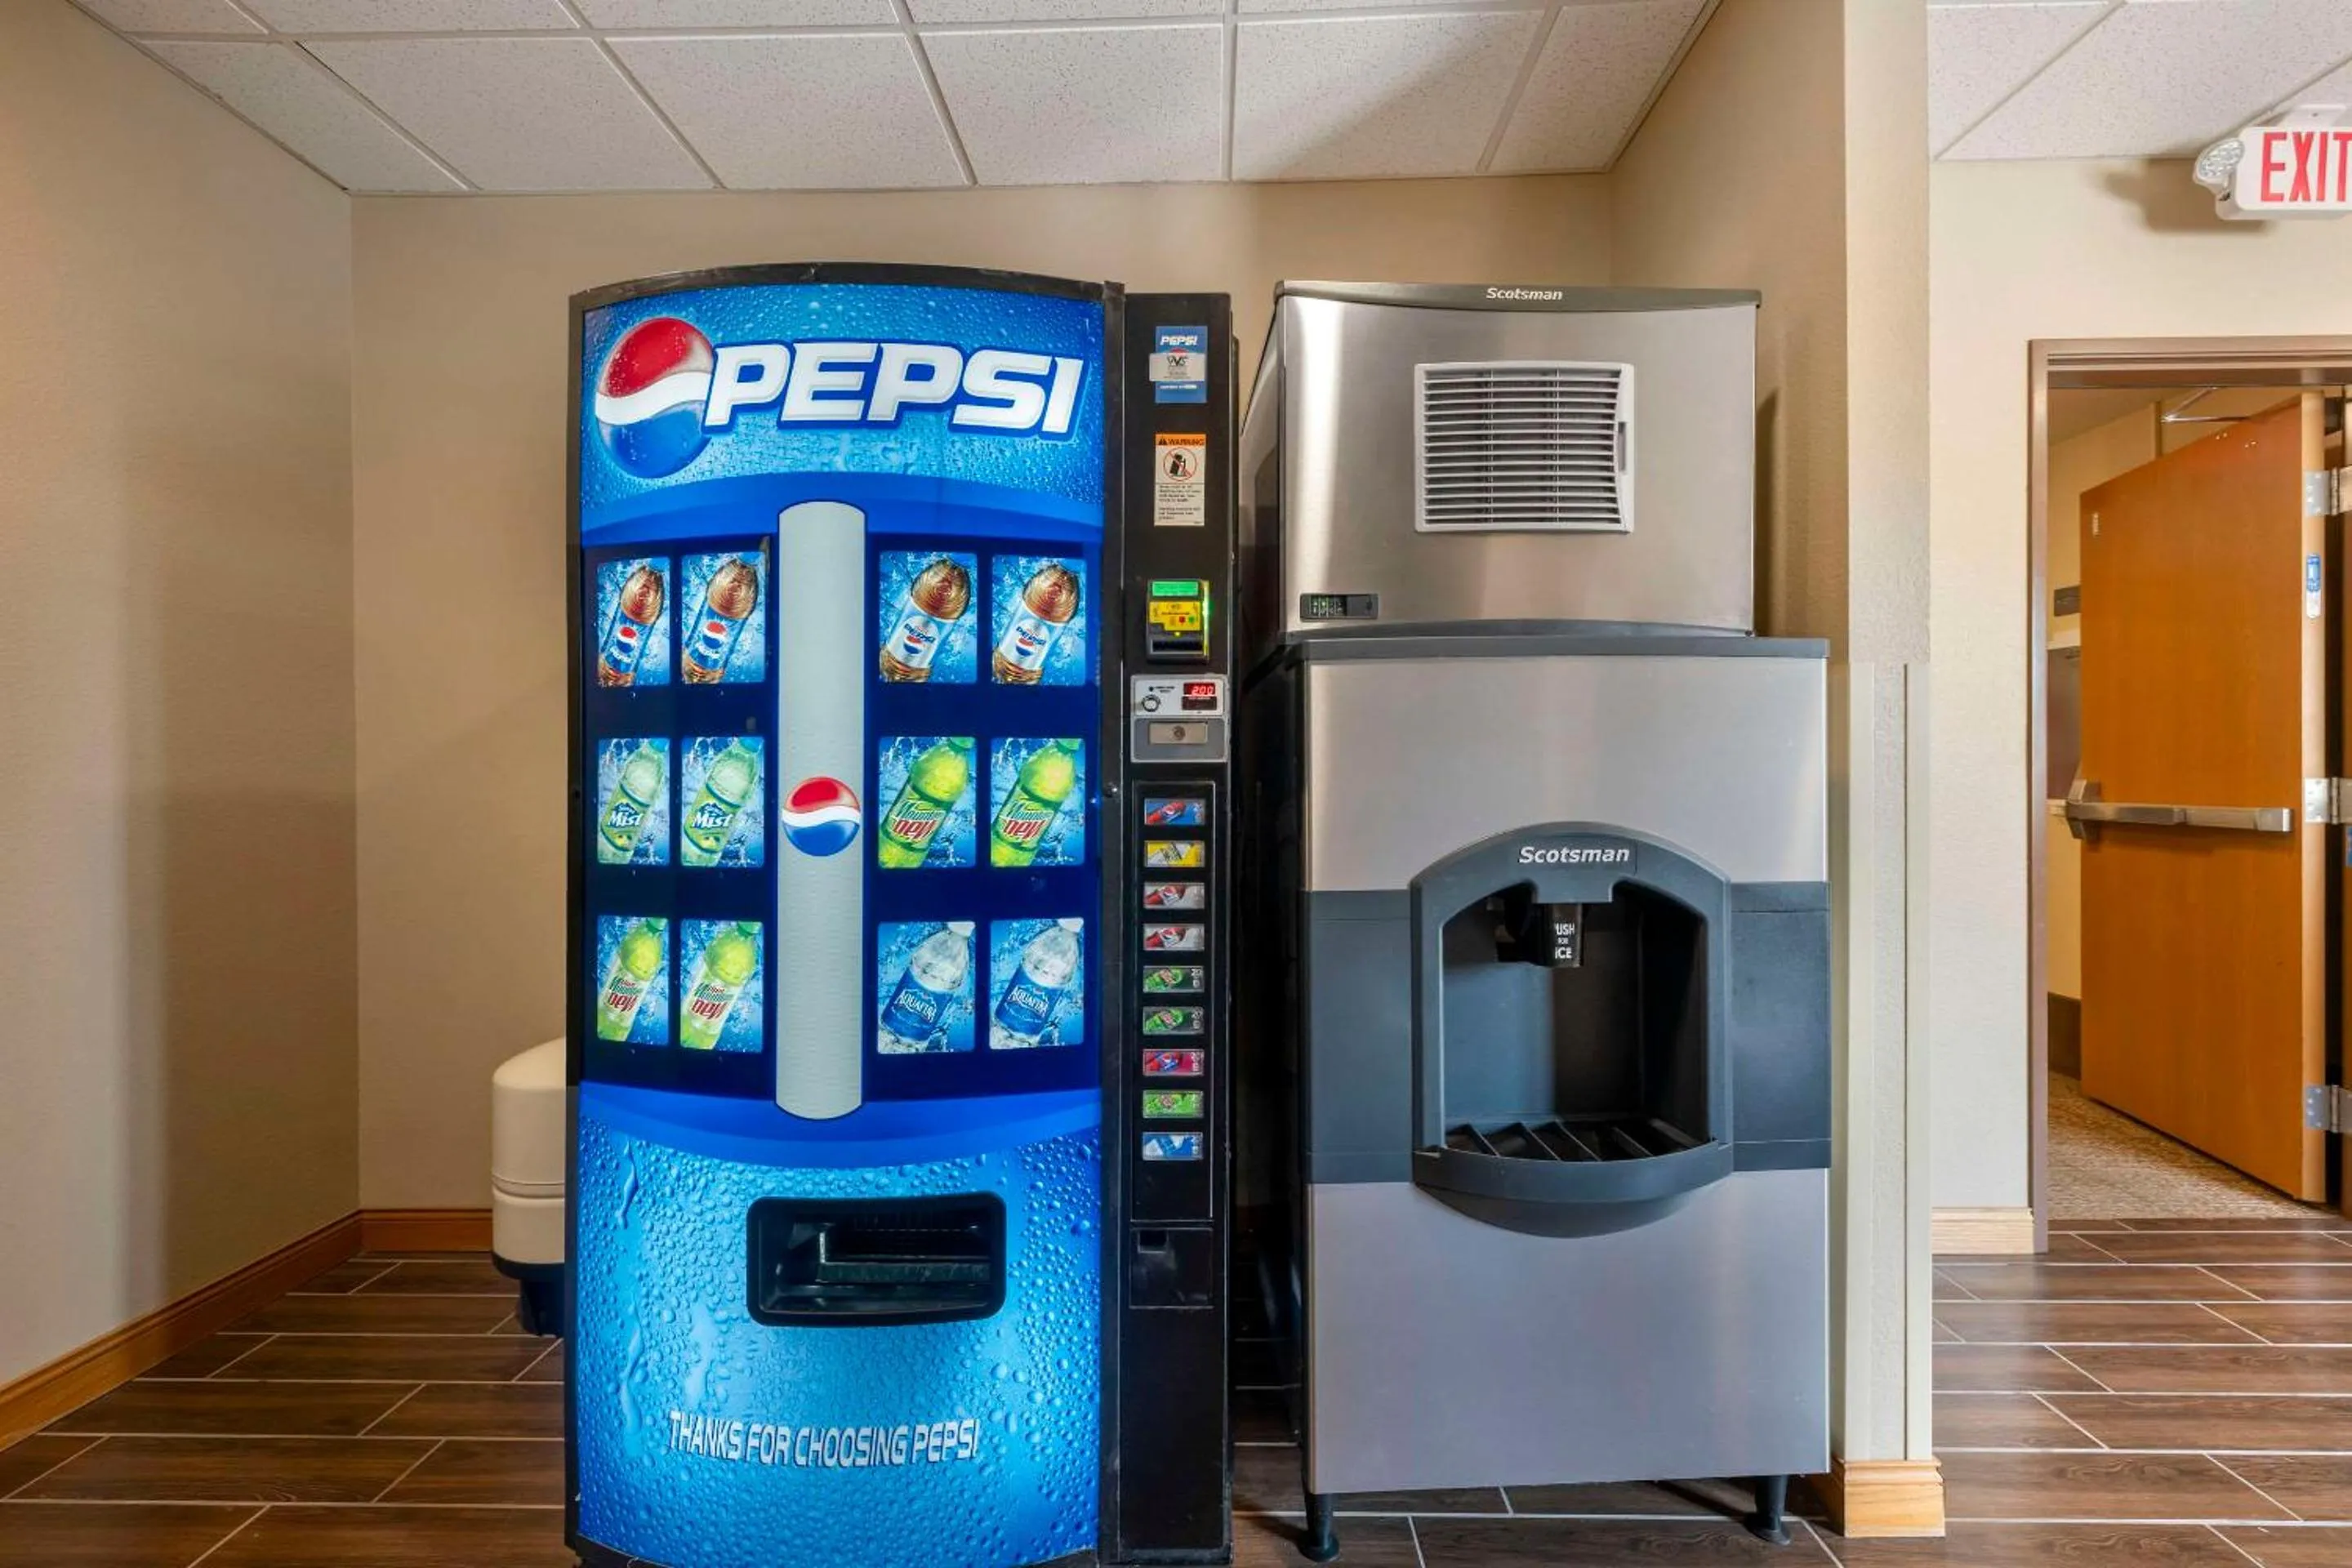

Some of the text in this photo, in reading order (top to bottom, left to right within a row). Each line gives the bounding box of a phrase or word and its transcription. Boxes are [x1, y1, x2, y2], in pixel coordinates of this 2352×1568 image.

[2261, 131, 2352, 202] EXIT
[1486, 287, 1563, 301] Scotsman
[1160, 335, 1198, 346] PEPSI
[702, 341, 1085, 434] PEPSI
[1168, 438, 1205, 446] WARNING
[1518, 846, 1630, 863] Scotsman
[1554, 947, 1572, 959] ICE
[668, 1410, 980, 1468] THANKS FOR CHOOSING PEPSI
